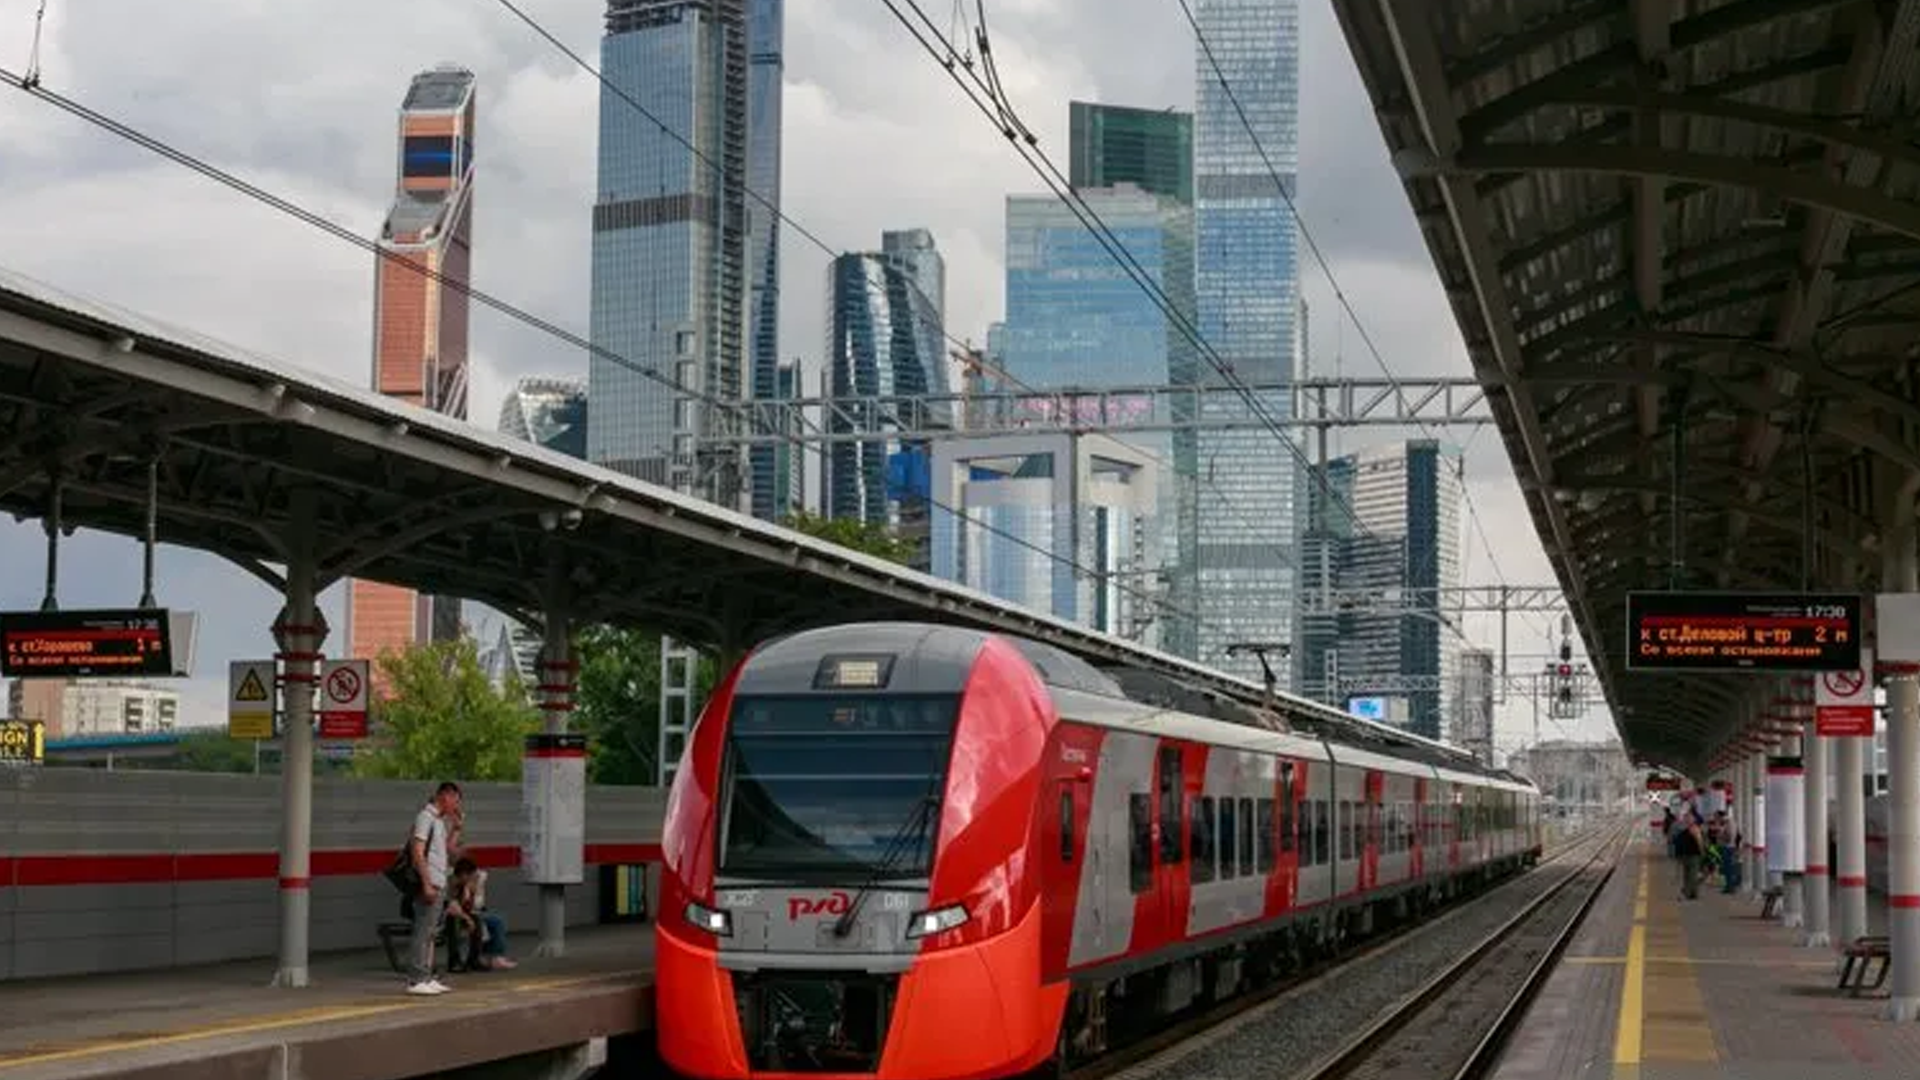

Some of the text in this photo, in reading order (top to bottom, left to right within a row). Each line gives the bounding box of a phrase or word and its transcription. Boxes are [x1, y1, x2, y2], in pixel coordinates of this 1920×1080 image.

[1806, 605, 1846, 618] 17:30
[1815, 626, 1827, 642] 2
[1836, 629, 1848, 642] м
[1641, 643, 1660, 655] Со
